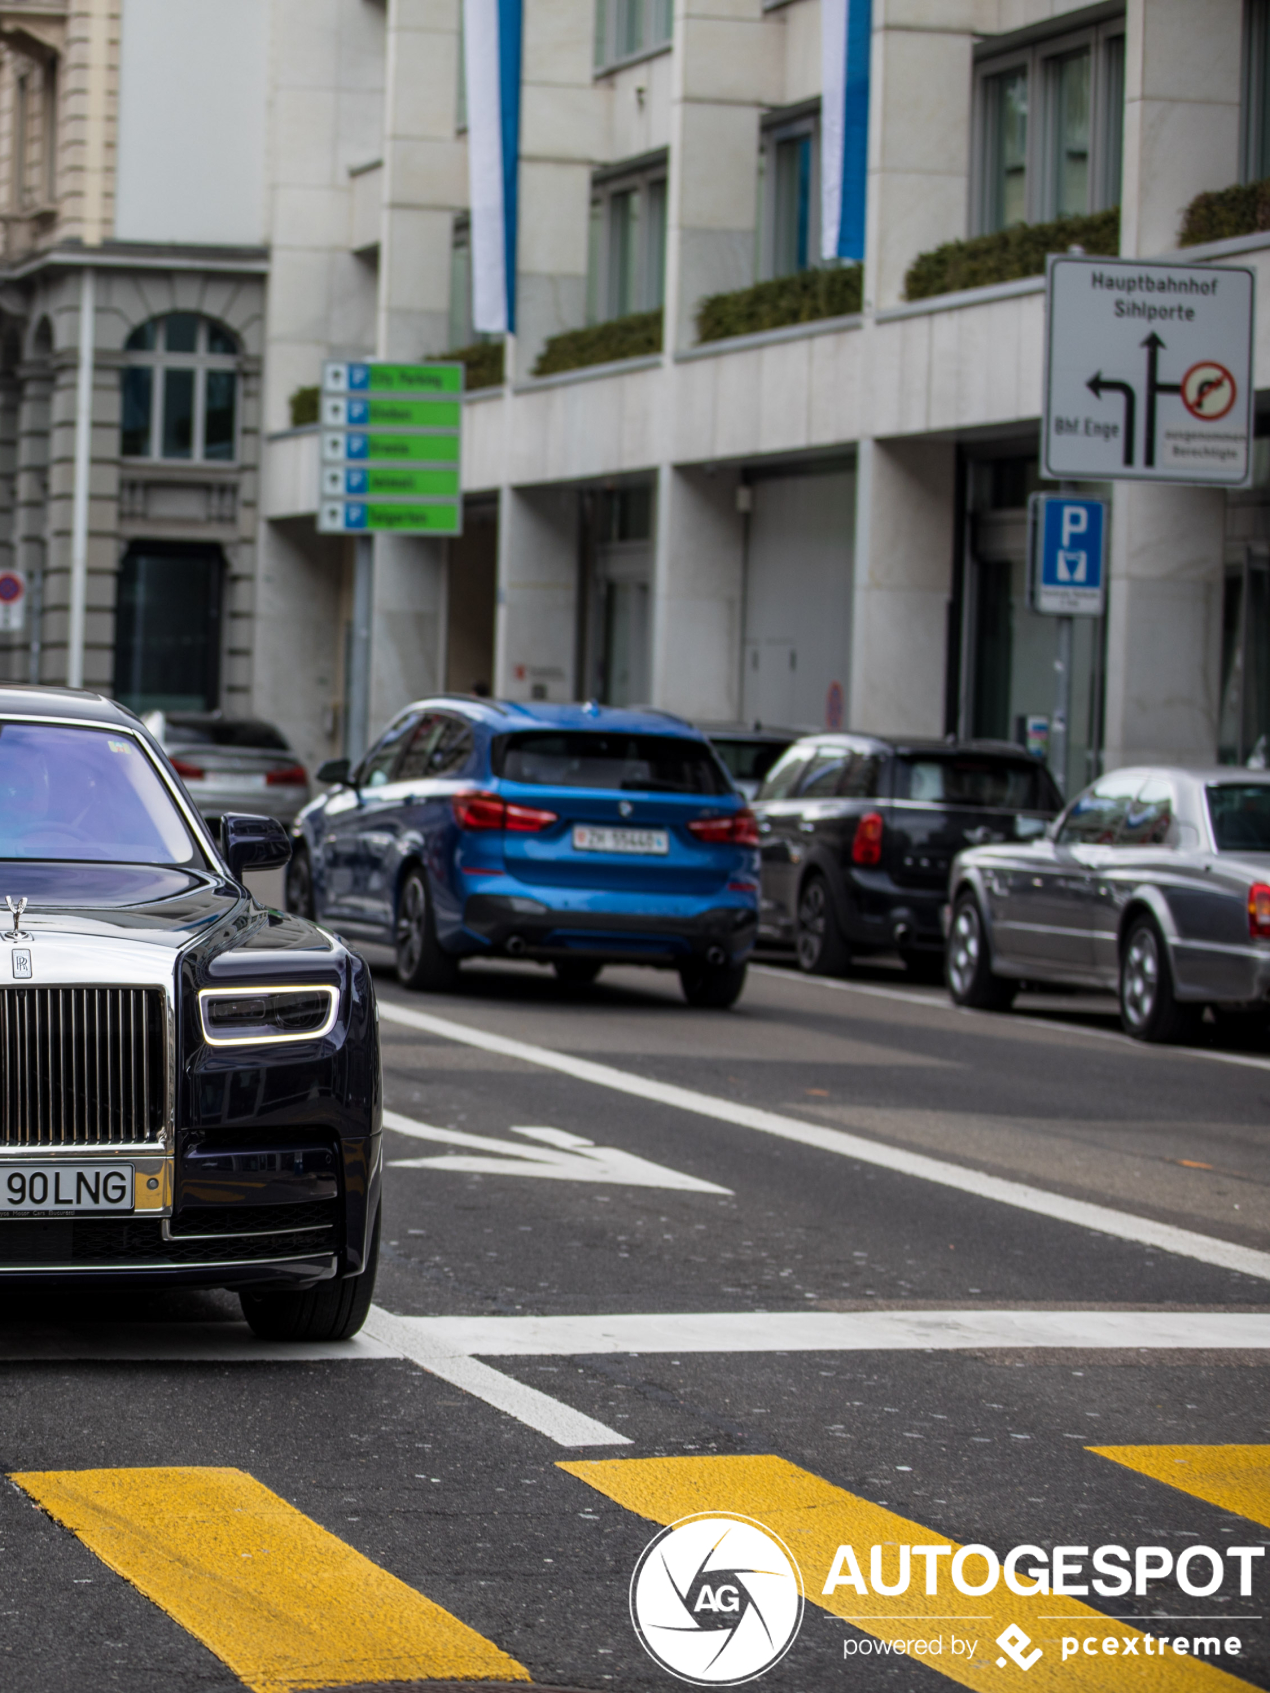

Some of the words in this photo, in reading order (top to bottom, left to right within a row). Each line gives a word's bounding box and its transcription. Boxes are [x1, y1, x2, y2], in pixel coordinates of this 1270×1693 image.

[1091, 271, 1218, 296] Hauptbahnhof
[1114, 299, 1195, 323] Sihlporte
[1055, 415, 1080, 436] Bhf
[1084, 417, 1120, 441] Enge
[1062, 505, 1088, 548] P
[7, 1171, 127, 1205] 90LNG
